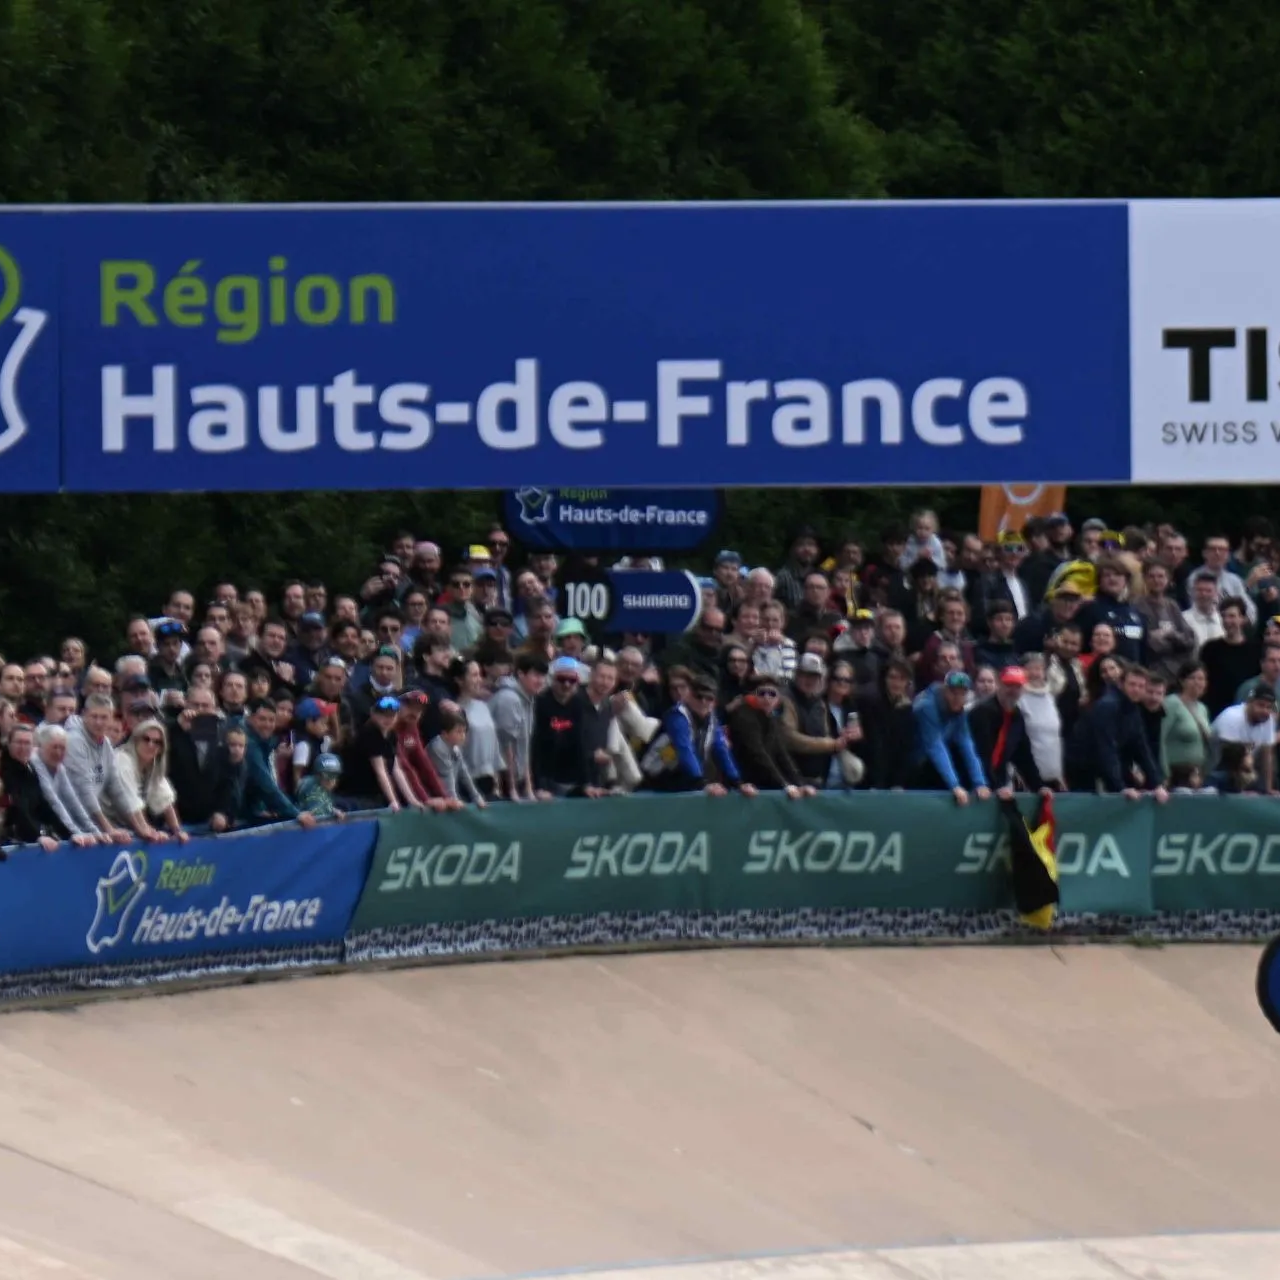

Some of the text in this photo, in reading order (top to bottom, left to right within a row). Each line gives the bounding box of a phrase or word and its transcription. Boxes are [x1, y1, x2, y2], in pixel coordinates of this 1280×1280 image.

[100, 256, 394, 343] Région
[101, 358, 1028, 452] Hauts-de-France
[1162, 421, 1258, 444] SWISS
[558, 504, 708, 525] Hauts-de-France
[565, 582, 608, 619] 100
[955, 831, 1131, 878] SKDA
[156, 857, 215, 896] Région
[131, 894, 321, 945] Hauts-de-France
